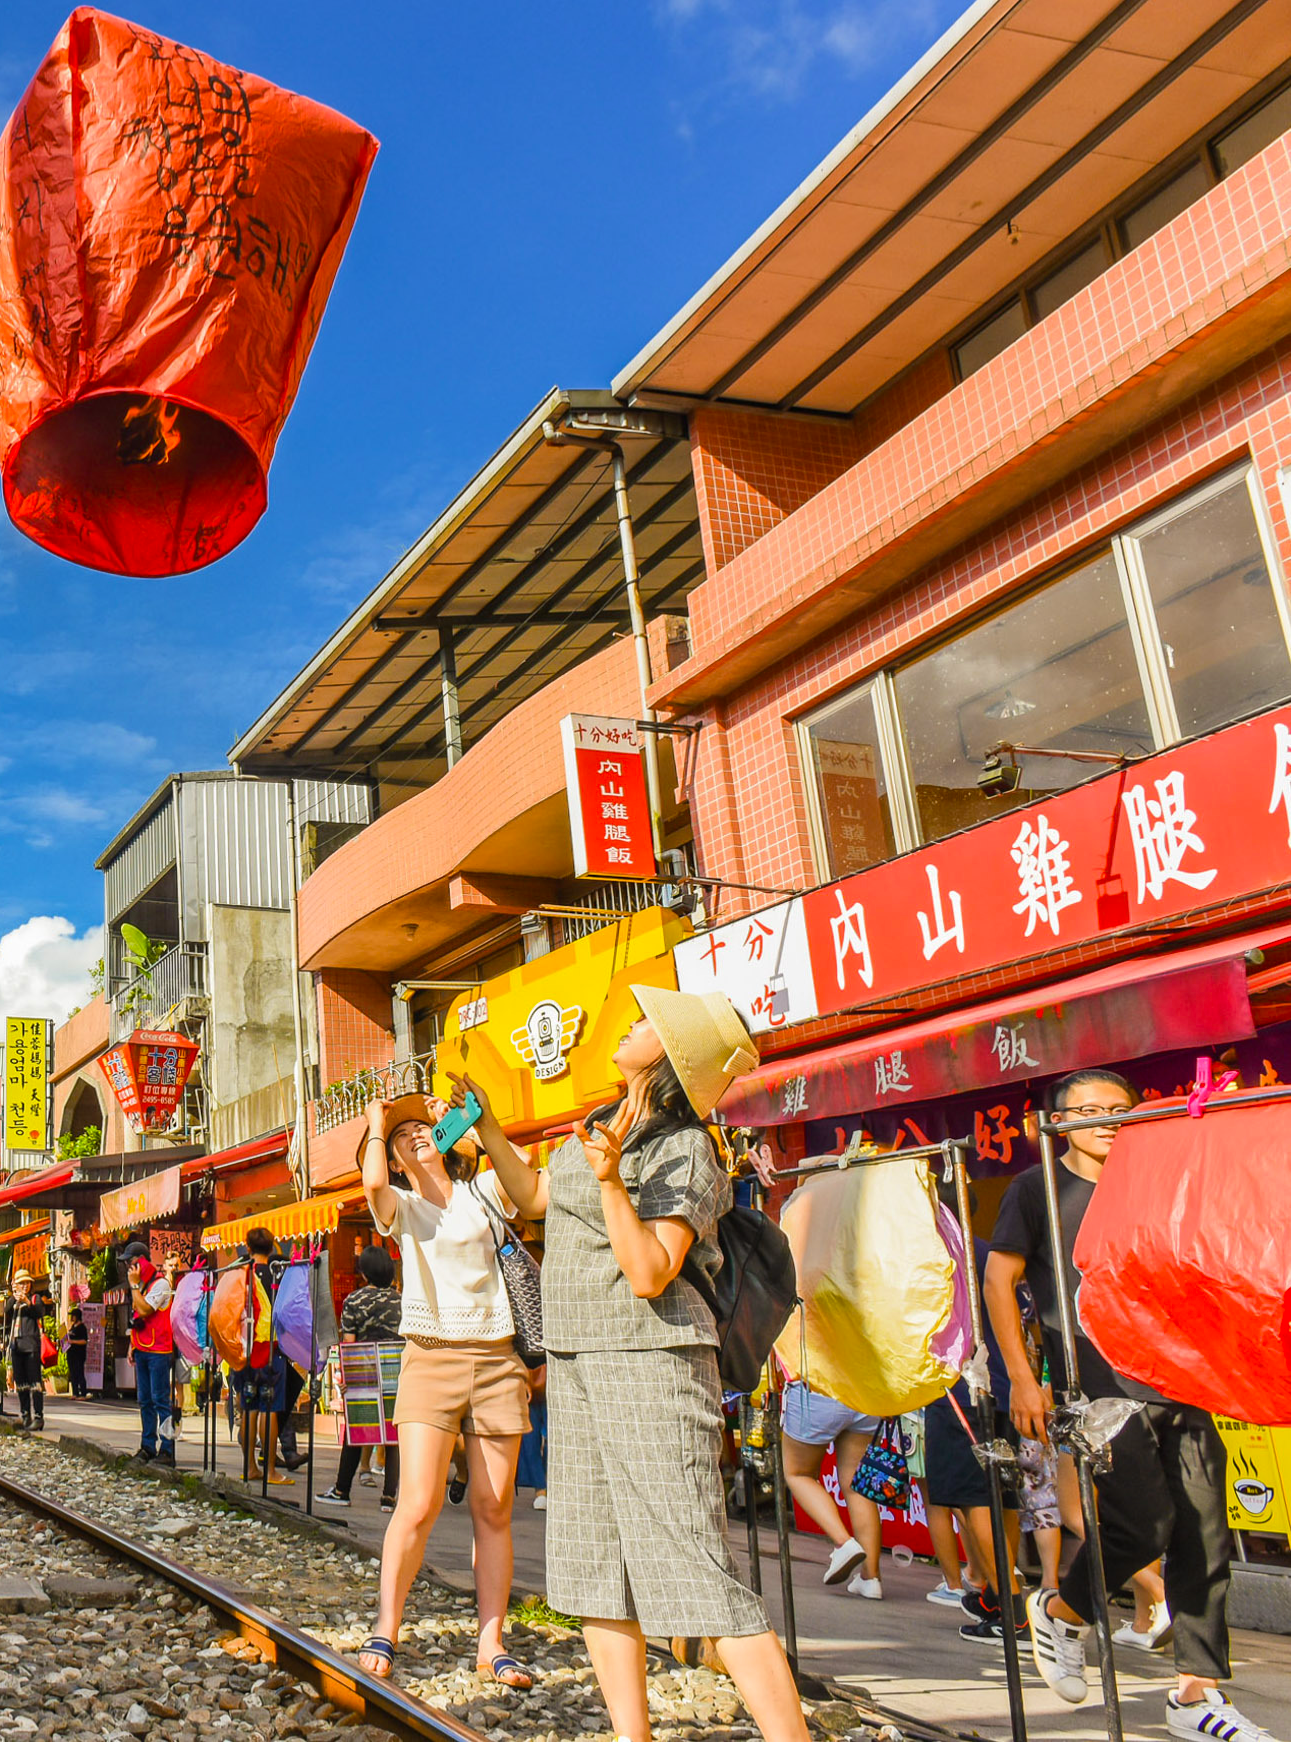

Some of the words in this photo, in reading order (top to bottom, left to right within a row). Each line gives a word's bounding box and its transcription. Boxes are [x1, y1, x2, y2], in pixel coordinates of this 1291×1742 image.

[574, 723, 637, 746] 十分好吃
[597, 759, 634, 864] 內山雞腿飯
[829, 722, 1291, 990] 內山雞腿
[699, 918, 774, 976] 十分
[729, 984, 787, 1027] 吃
[9, 1021, 28, 1089] 가용엄마
[148, 1047, 177, 1067] 十分
[535, 1060, 564, 1078] DESIGN
[147, 1066, 177, 1085] 客棧
[8, 1102, 28, 1136] 천등
